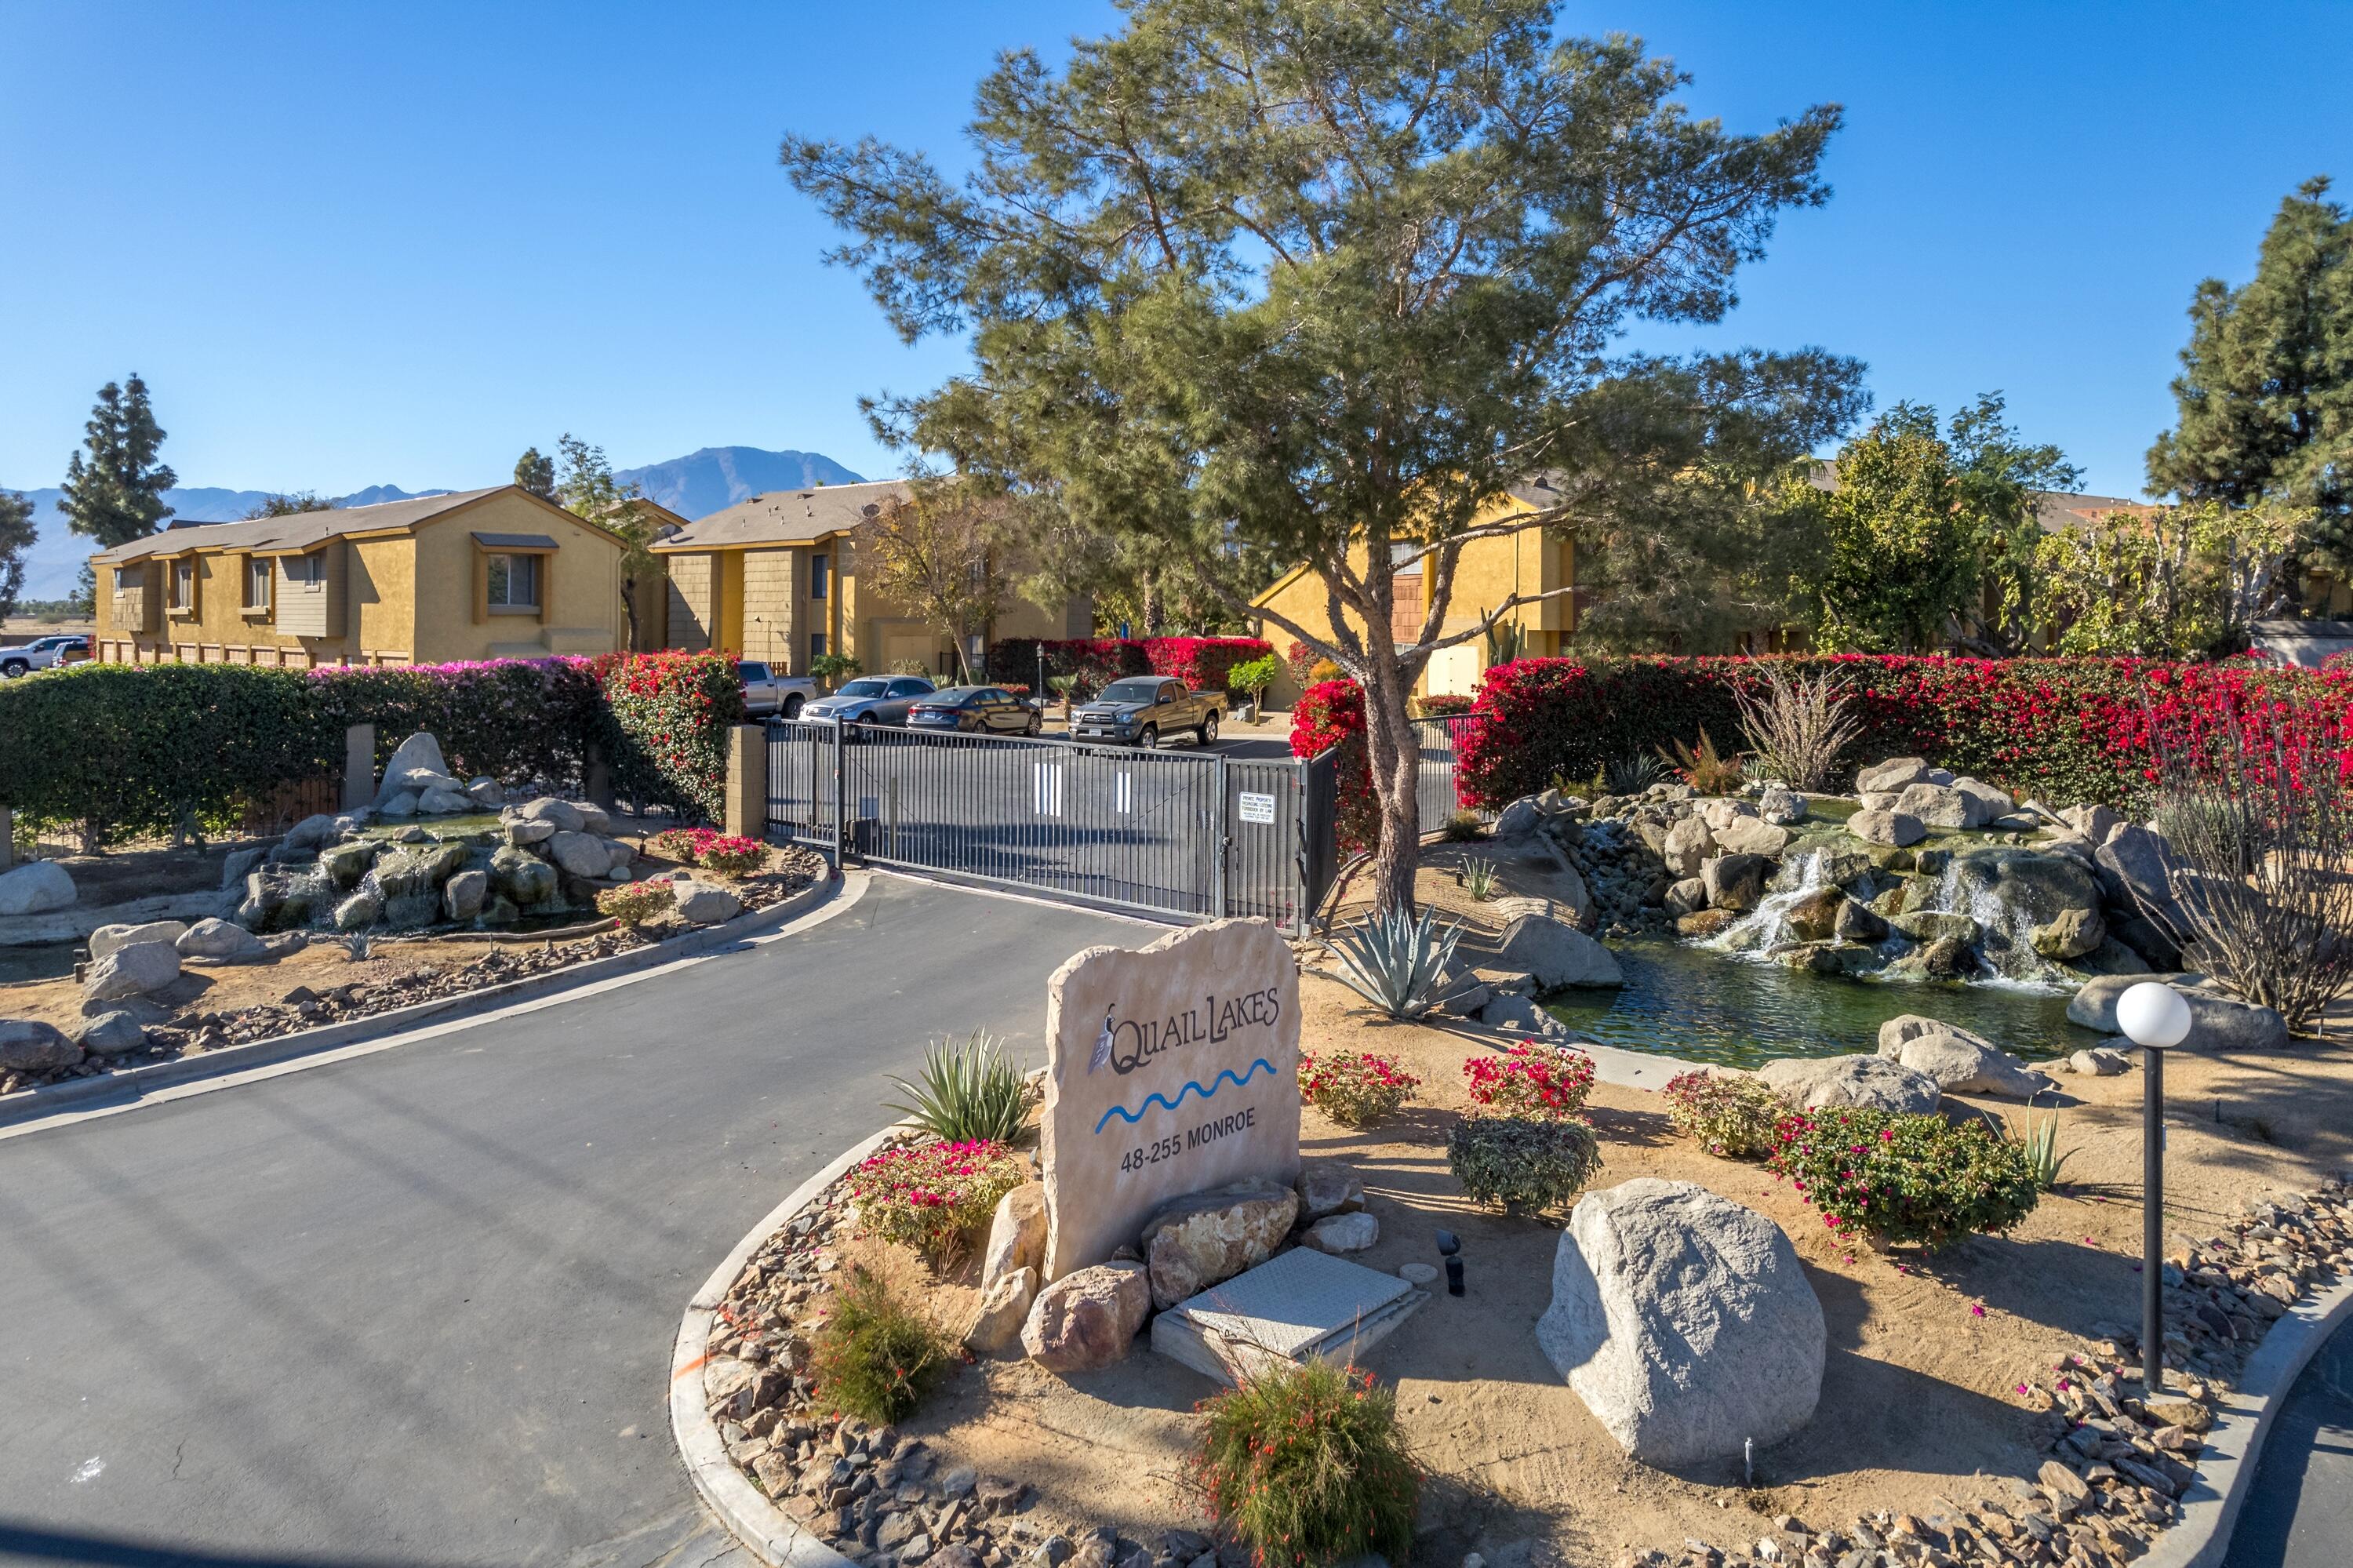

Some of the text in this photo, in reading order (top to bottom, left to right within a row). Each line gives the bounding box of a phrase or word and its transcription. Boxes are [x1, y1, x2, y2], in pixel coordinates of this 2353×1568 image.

[1111, 988, 1279, 1075] QUAIL LAKES
[1121, 1108, 1256, 1173] 48-255 MONROE
